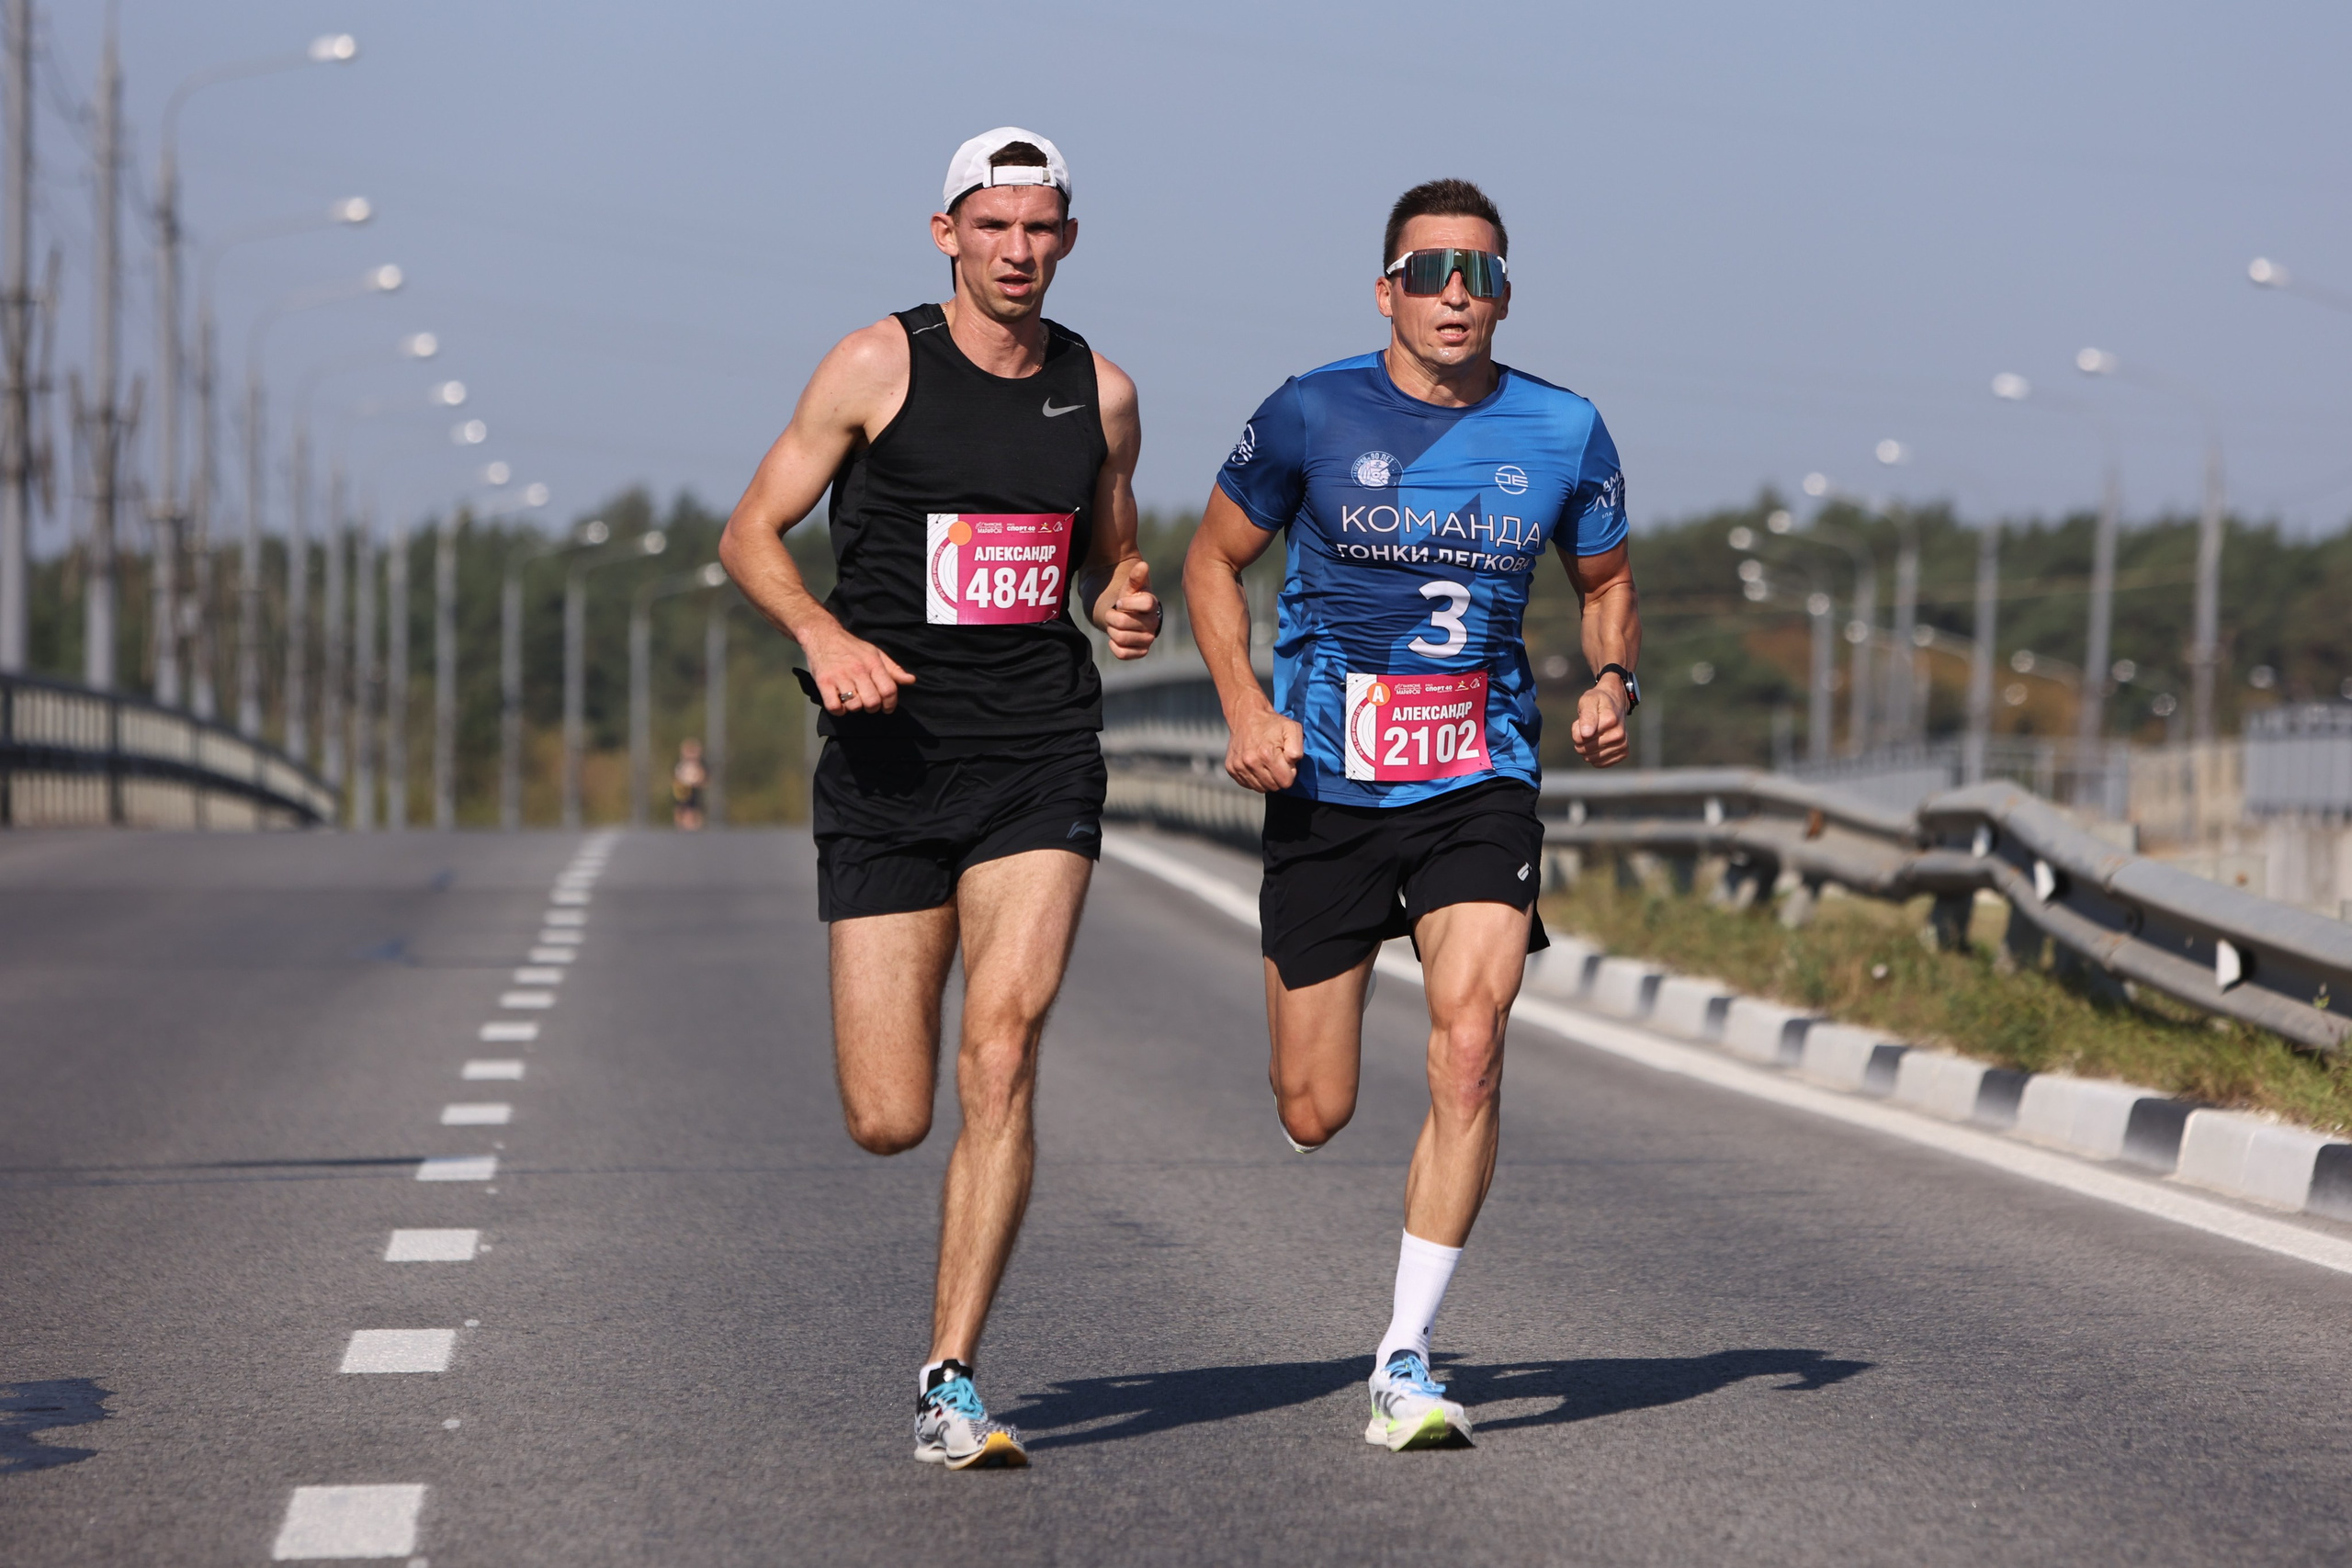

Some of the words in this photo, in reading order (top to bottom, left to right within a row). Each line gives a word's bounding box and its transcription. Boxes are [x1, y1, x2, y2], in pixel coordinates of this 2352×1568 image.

[1380, 454, 1395, 464] ЛЕТ
[1341, 504, 1542, 551] КОМАНДА
[974, 545, 1057, 563] АЛЕКСАНДР
[1335, 543, 1429, 563] ГОНКИ
[1432, 547, 1530, 572] ЛЕГКОВА
[966, 565, 1060, 609] 4842
[1407, 580, 1472, 660] 3
[1373, 685, 1385, 703] А
[1392, 701, 1473, 721] АЛЕКСАНДР
[1383, 719, 1481, 766] 2102
